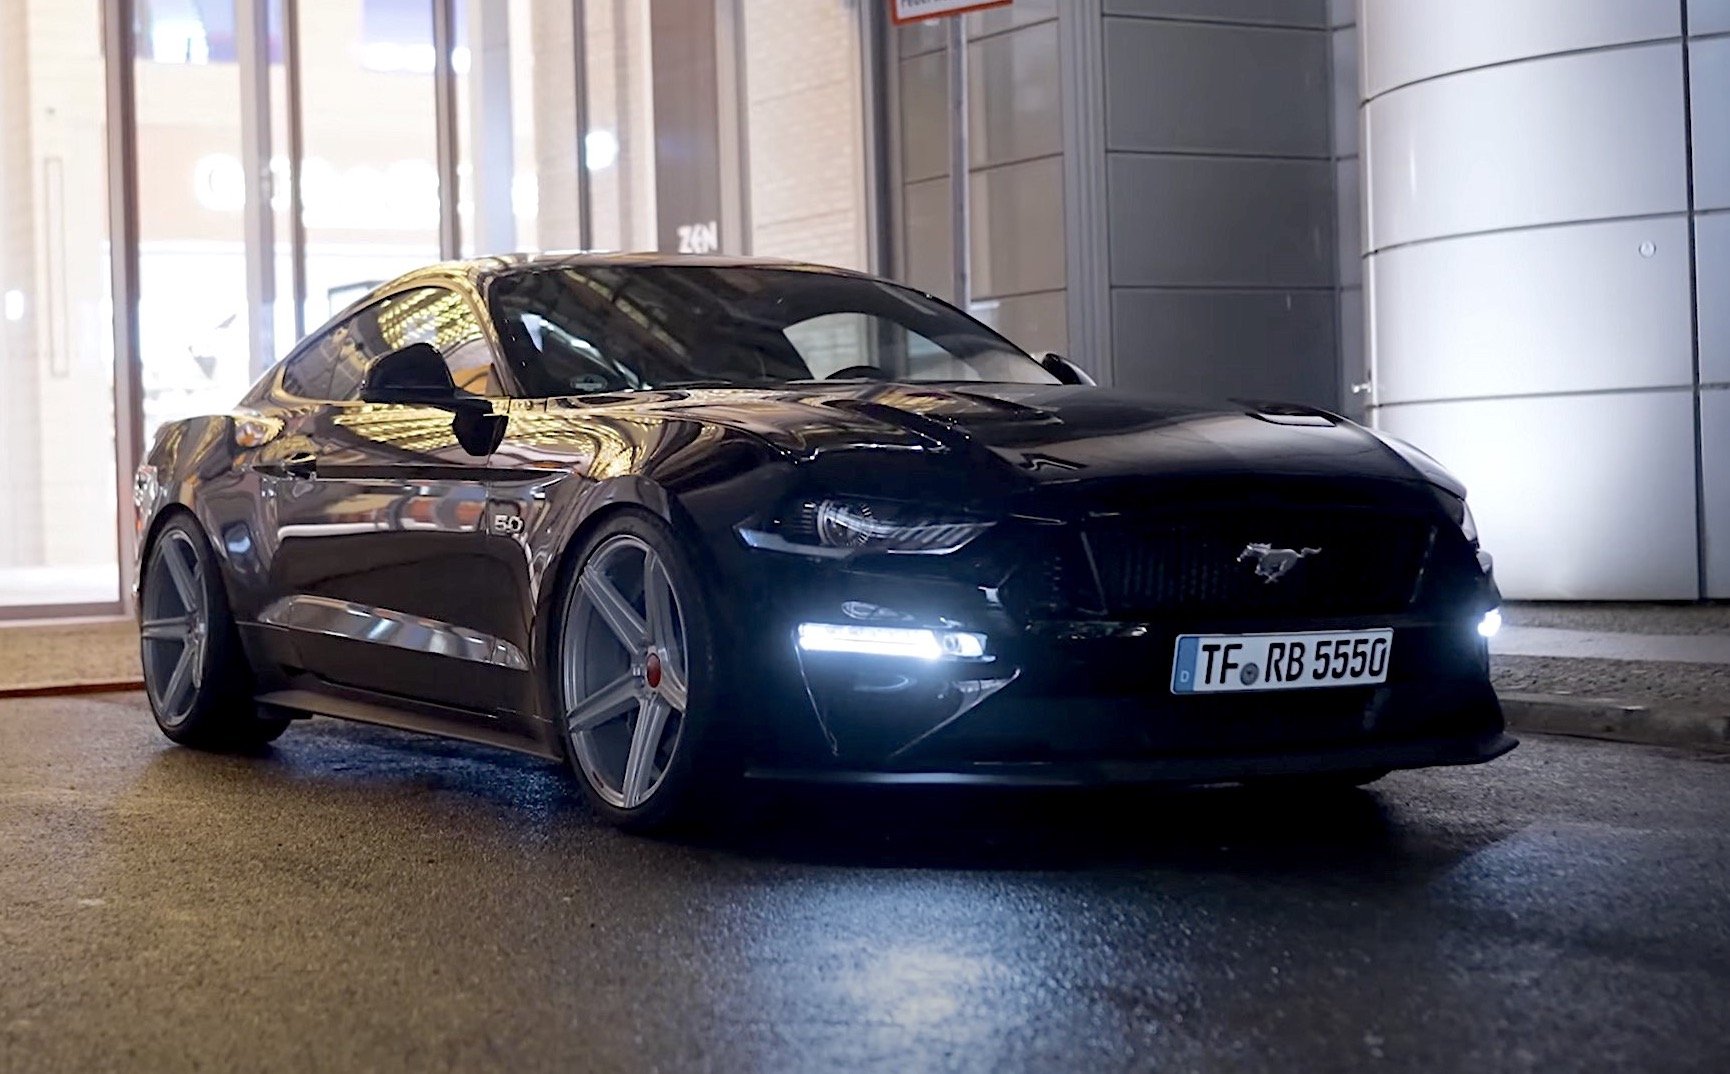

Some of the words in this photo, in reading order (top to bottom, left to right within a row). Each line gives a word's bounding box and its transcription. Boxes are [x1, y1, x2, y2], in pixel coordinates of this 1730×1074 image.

[1202, 643, 1243, 685] TF
[1265, 642, 1306, 683] RB
[1312, 637, 1388, 680] 5550
[1180, 670, 1190, 683] D
